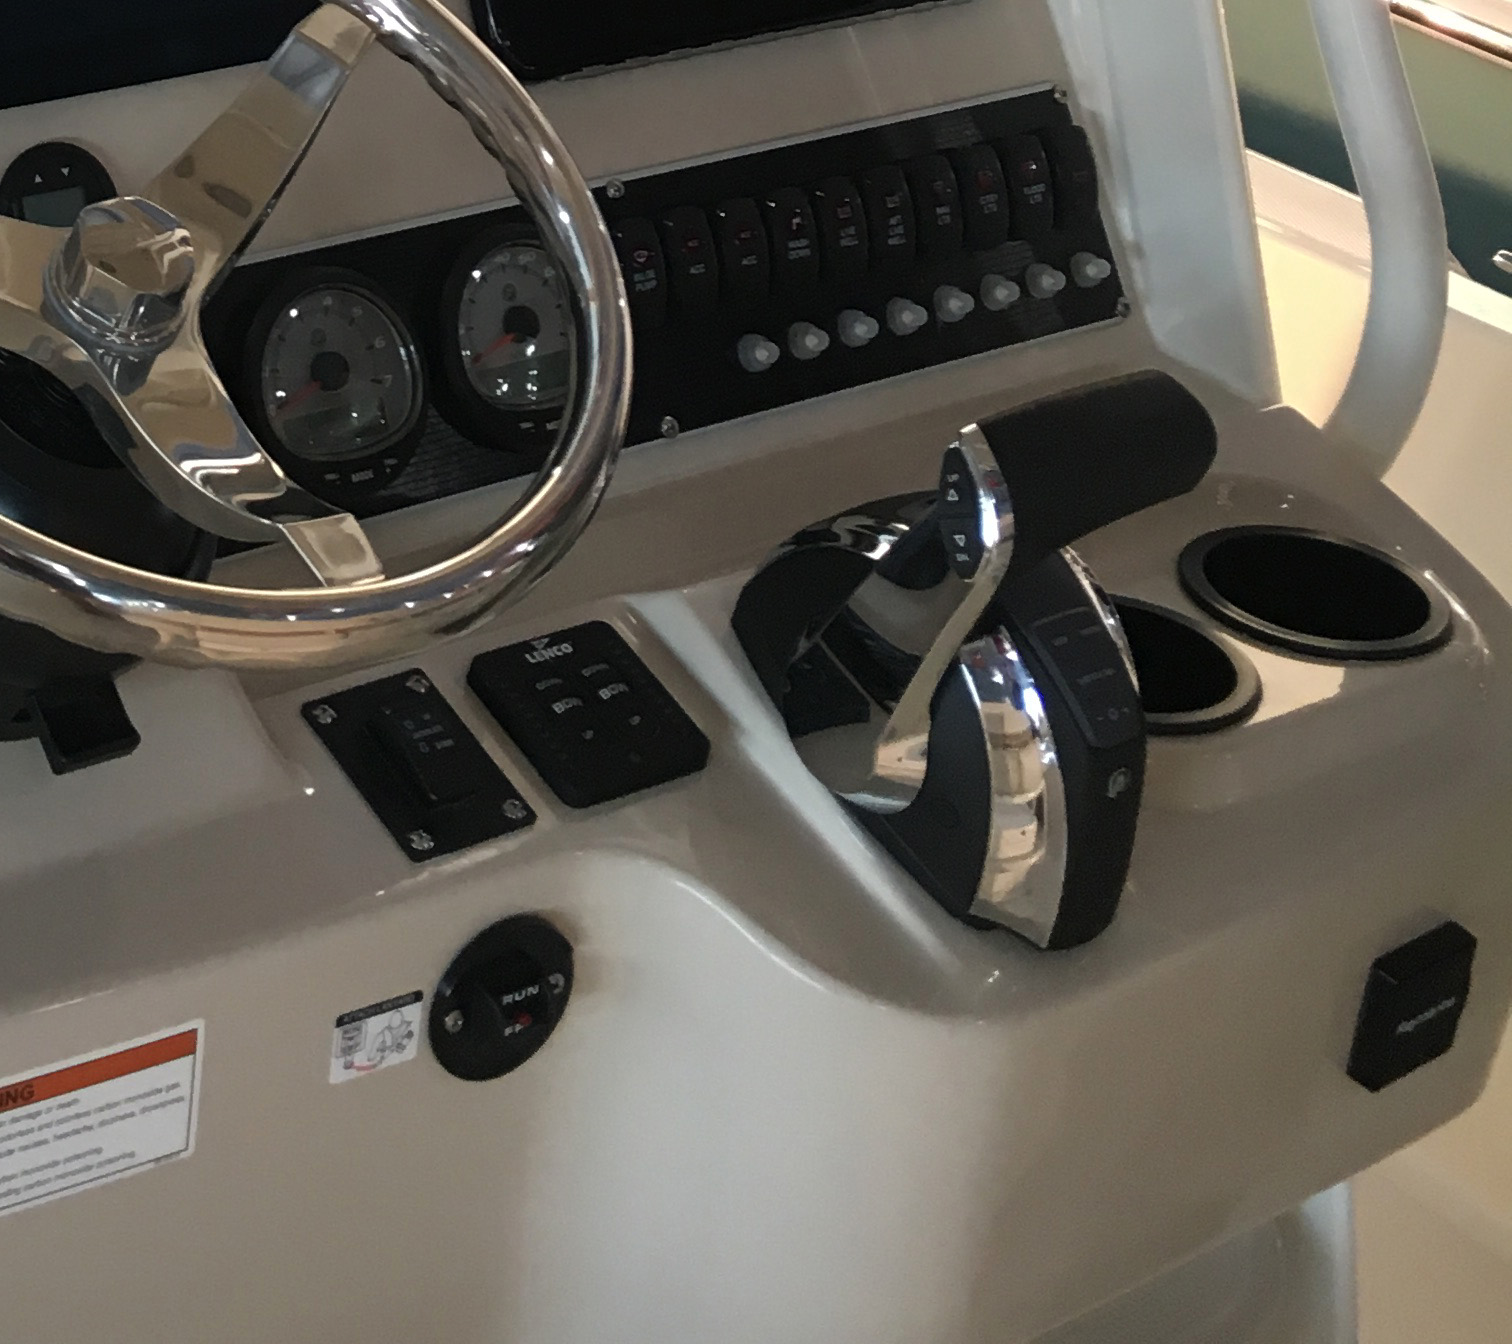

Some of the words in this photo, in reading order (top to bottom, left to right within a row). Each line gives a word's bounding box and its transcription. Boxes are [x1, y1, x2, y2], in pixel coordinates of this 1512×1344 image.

[374, 336, 386, 348] 6
[525, 642, 574, 664] LENCO
[502, 985, 540, 1005] RUN
